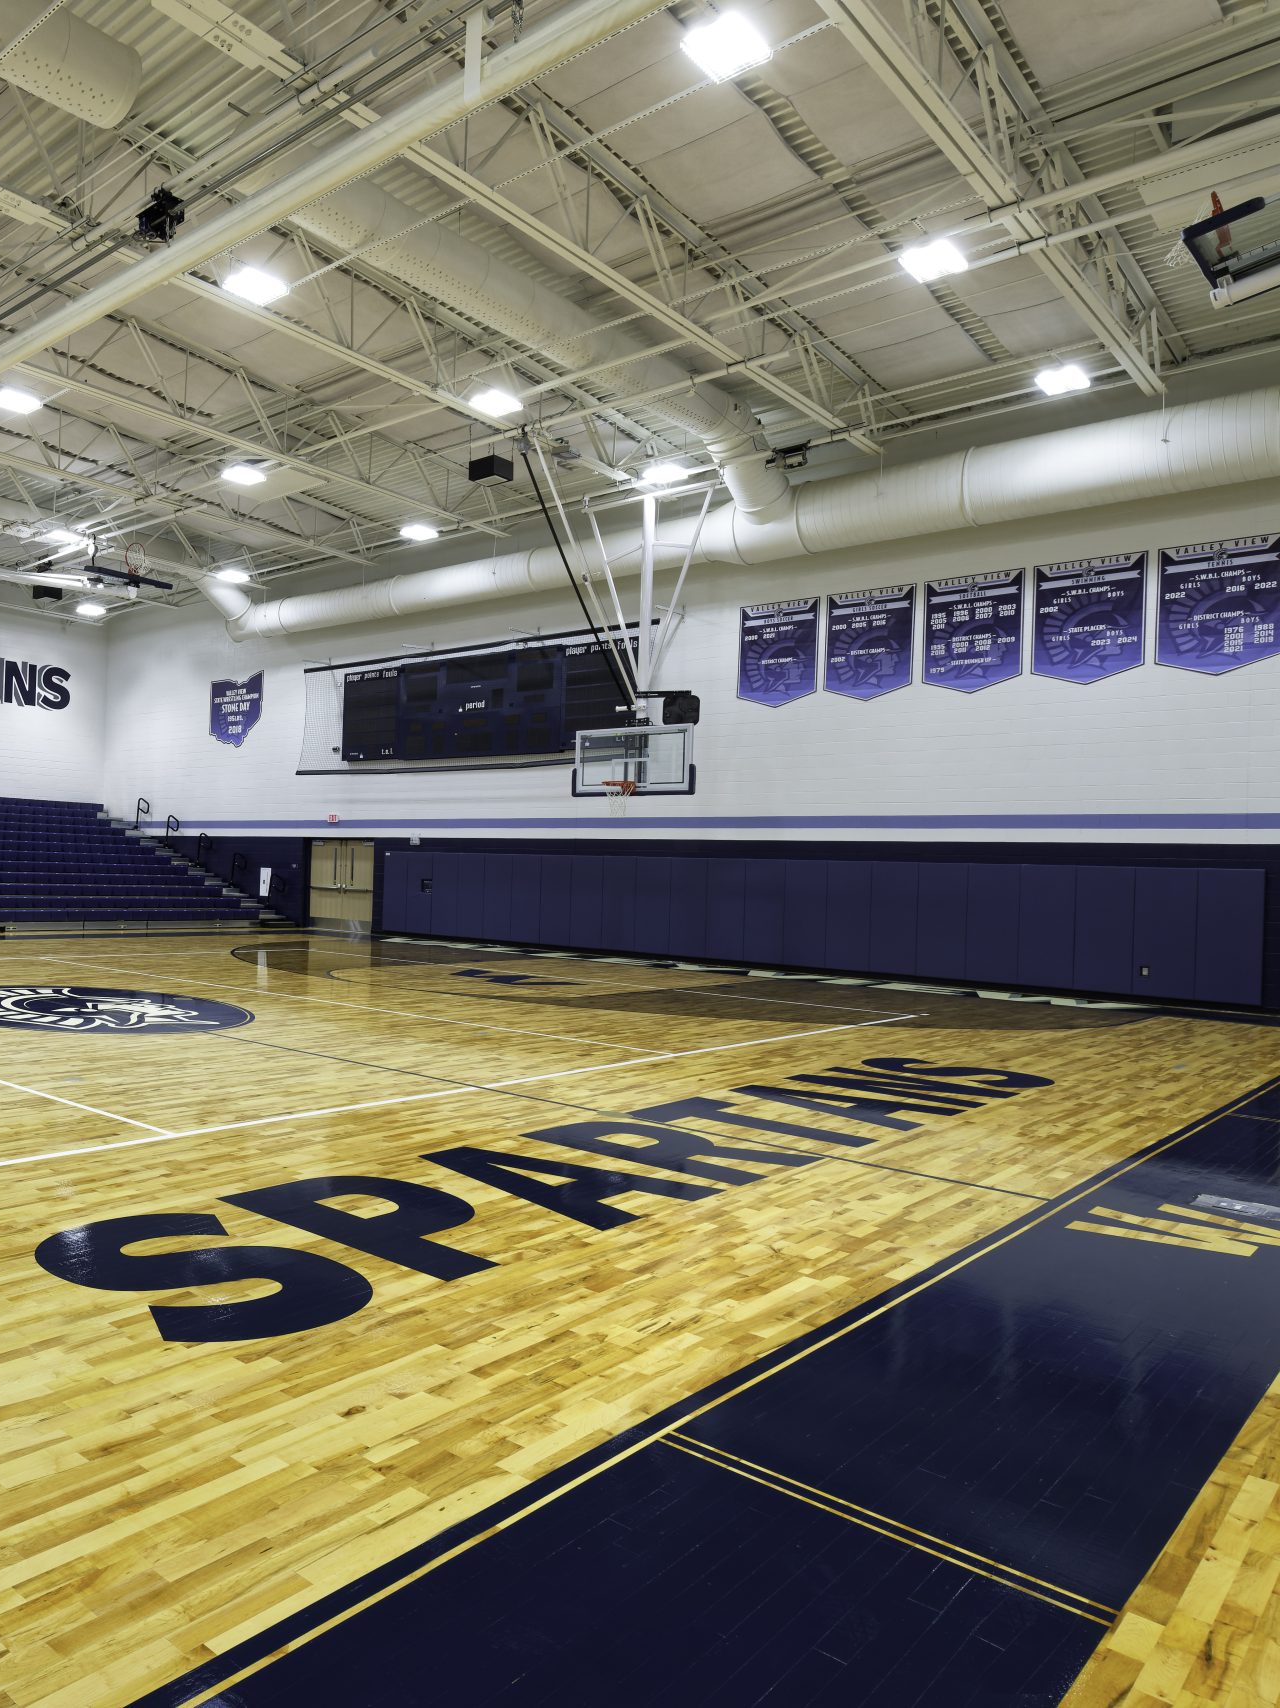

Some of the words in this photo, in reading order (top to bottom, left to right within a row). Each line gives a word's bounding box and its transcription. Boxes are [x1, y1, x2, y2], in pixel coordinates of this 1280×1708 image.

[1176, 543, 1223, 555] VALLEY
[1235, 536, 1269, 547] VIEW
[1049, 561, 1091, 571] VALLEY
[1101, 555, 1131, 564] VIEW
[1208, 560, 1233, 568] TENNIS
[938, 577, 975, 587] VALLEY
[984, 572, 1010, 581] VIEW
[1221, 569, 1245, 578] CHAMPS
[1072, 576, 1106, 584] SWIMMING
[1226, 585, 1245, 593] 2016
[1255, 581, 1277, 589] 2022
[839, 591, 872, 600] VALLEY
[880, 587, 903, 595] VIEW
[751, 604, 781, 612] VALLEY
[1220, 611, 1244, 619] CHAMPS
[566, 646, 587, 656] player
[591, 642, 611, 653] ponts
[618, 640, 638, 650] fols
[346, 672, 361, 682] player
[382, 669, 398, 678] fouls
[222, 703, 238, 713] STONE
[240, 702, 250, 711] DAY
[465, 700, 485, 710] period
[34, 1057, 1056, 1343] SPARTANS
